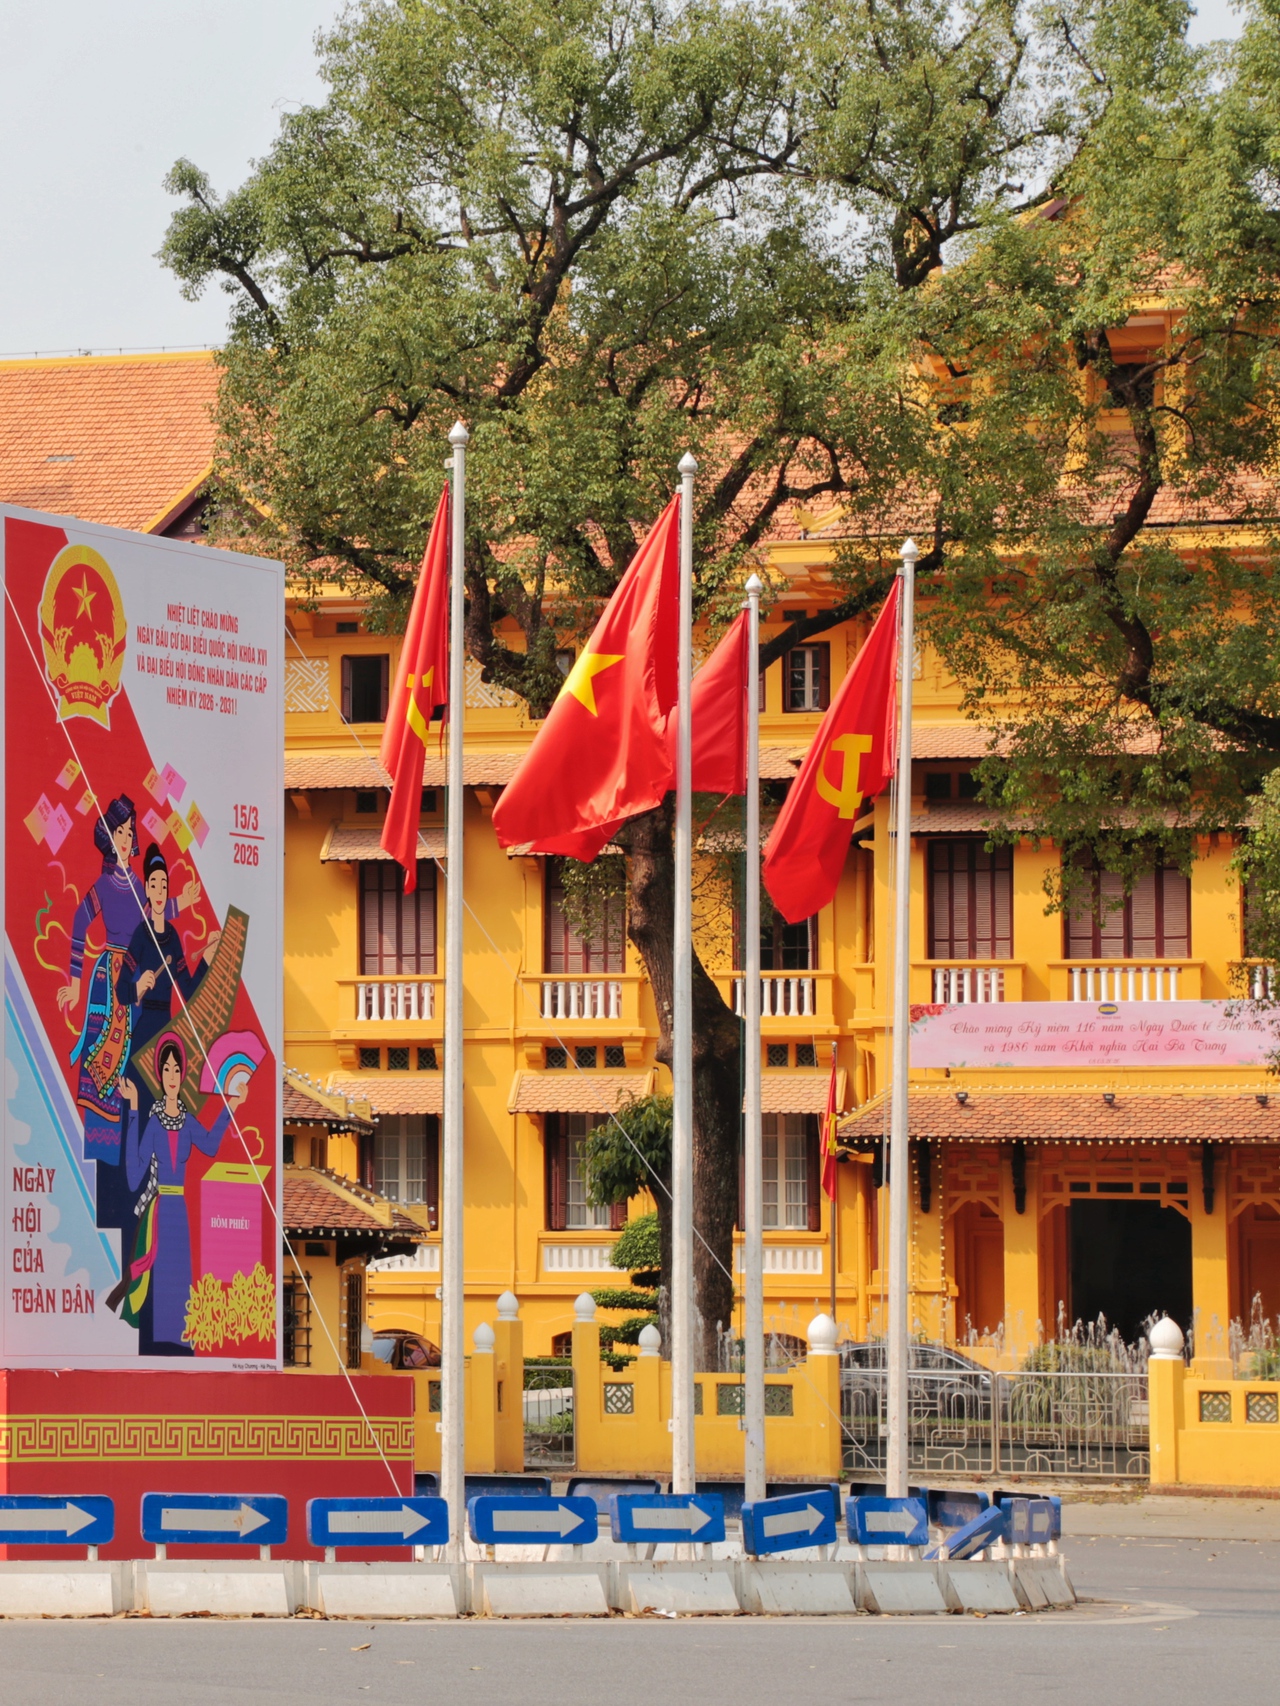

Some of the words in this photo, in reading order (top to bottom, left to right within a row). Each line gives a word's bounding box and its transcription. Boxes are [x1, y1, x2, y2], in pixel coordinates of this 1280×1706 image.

[167, 602, 185, 627] NHIỆT
[187, 604, 200, 629] LIỆT
[201, 608, 218, 630] CHÀO
[220, 610, 238, 634] MỪNG
[137, 623, 154, 645] NGÀY
[170, 624, 180, 649] CỬ
[180, 633, 191, 655] ĐẠI
[193, 630, 207, 655] BIỂU
[209, 635, 225, 659] QUỐC
[227, 639, 237, 664] HỘI
[239, 642, 256, 665] KHÓA
[257, 648, 267, 666] XVI
[137, 651, 145, 672] VÀ
[147, 655, 157, 678] ĐẠI
[159, 652, 174, 678] BIỂU
[176, 658, 186, 683] HỘI
[206, 665, 224, 687] NHÂN
[226, 668, 238, 689] DÂN
[240, 670, 253, 692] CÁC
[254, 670, 267, 694] CẤP
[166, 684, 187, 709] NHIỆM
[189, 687, 197, 708] KỲ
[199, 692, 214, 711] 2026
[220, 696, 237, 715] 2031!
[233, 804, 259, 831] 15/3
[233, 843, 259, 867] 2026
[1076, 1022, 1097, 1033] 116
[1001, 1041, 1029, 1053] 1986
[13, 1162, 56, 1193] NGÀY
[12, 1202, 41, 1238] HỘI
[211, 1214, 228, 1228] HÒM
[229, 1216, 250, 1230] PHIẾU
[13, 1240, 45, 1273] CỦA
[12, 1282, 56, 1313] TOÀN
[61, 1283, 95, 1314] DÂN
